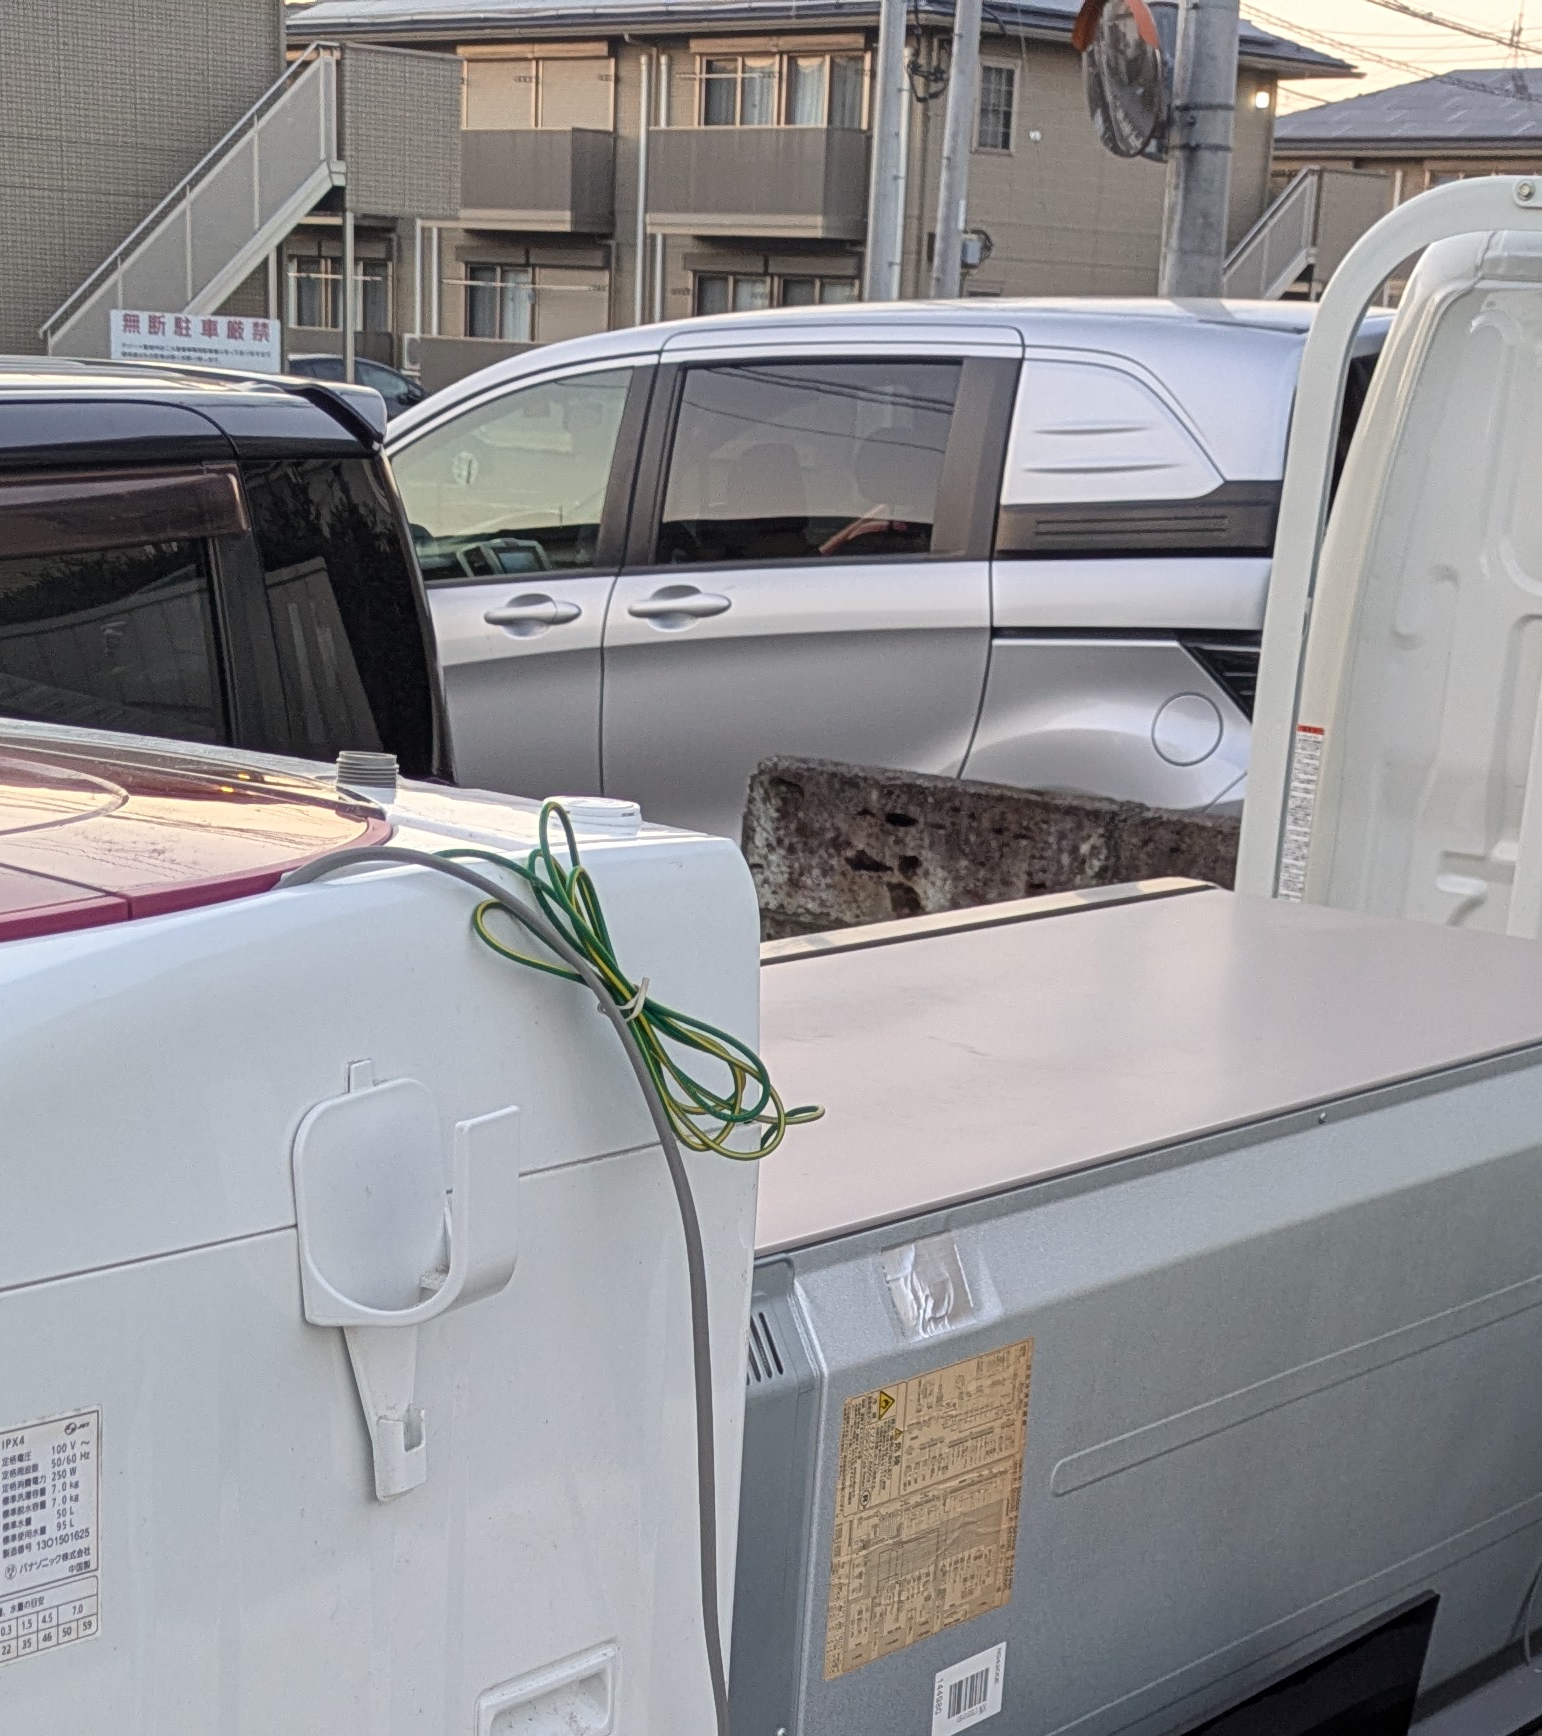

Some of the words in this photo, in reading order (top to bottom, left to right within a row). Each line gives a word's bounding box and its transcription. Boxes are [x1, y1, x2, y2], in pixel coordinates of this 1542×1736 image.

[121, 312, 271, 343] 無断駐車厳禁
[2, 1435, 25, 1450] IPX4
[52, 1443, 67, 1455] 100
[51, 1453, 77, 1469] 50/60
[51, 1469, 67, 1482] 250
[51, 1481, 67, 1495] 7.0
[52, 1494, 67, 1508] 7.0
